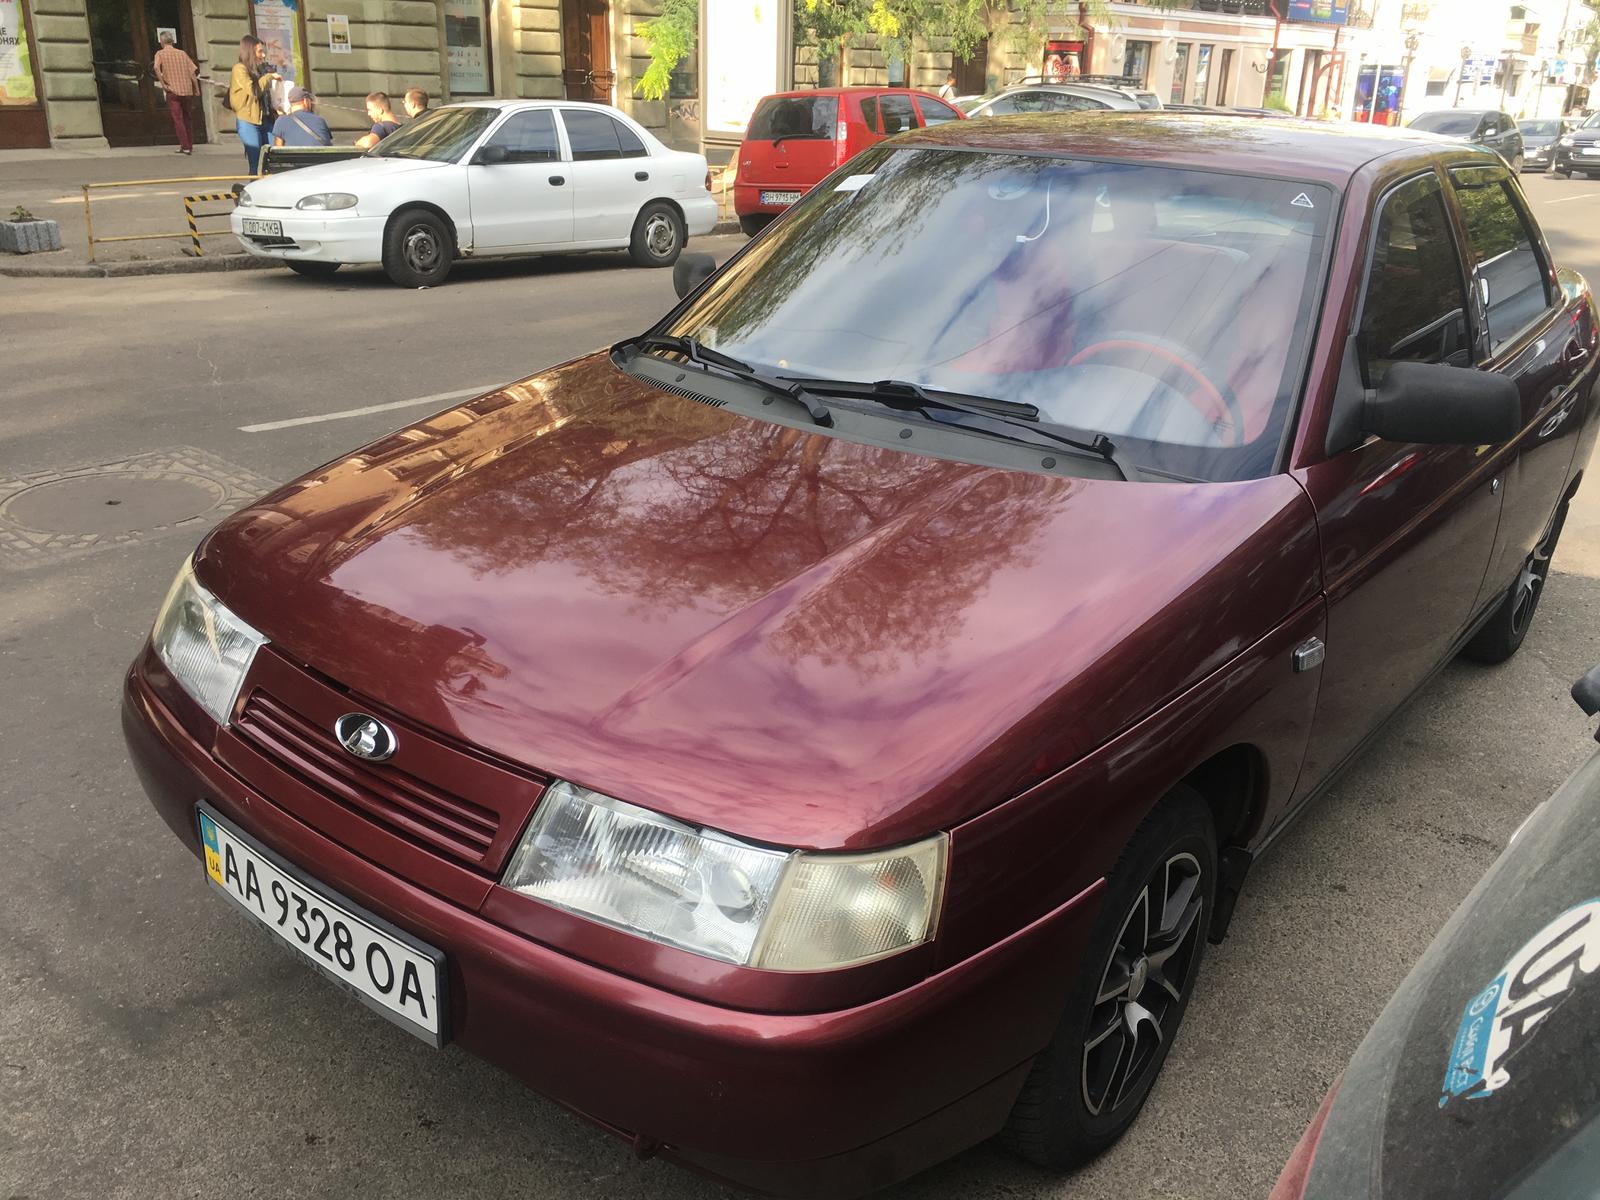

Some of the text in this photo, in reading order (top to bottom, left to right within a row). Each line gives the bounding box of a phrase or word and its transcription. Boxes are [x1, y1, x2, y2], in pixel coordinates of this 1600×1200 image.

[208, 855, 222, 876] UA
[225, 843, 428, 1019] AA 9328 OA
